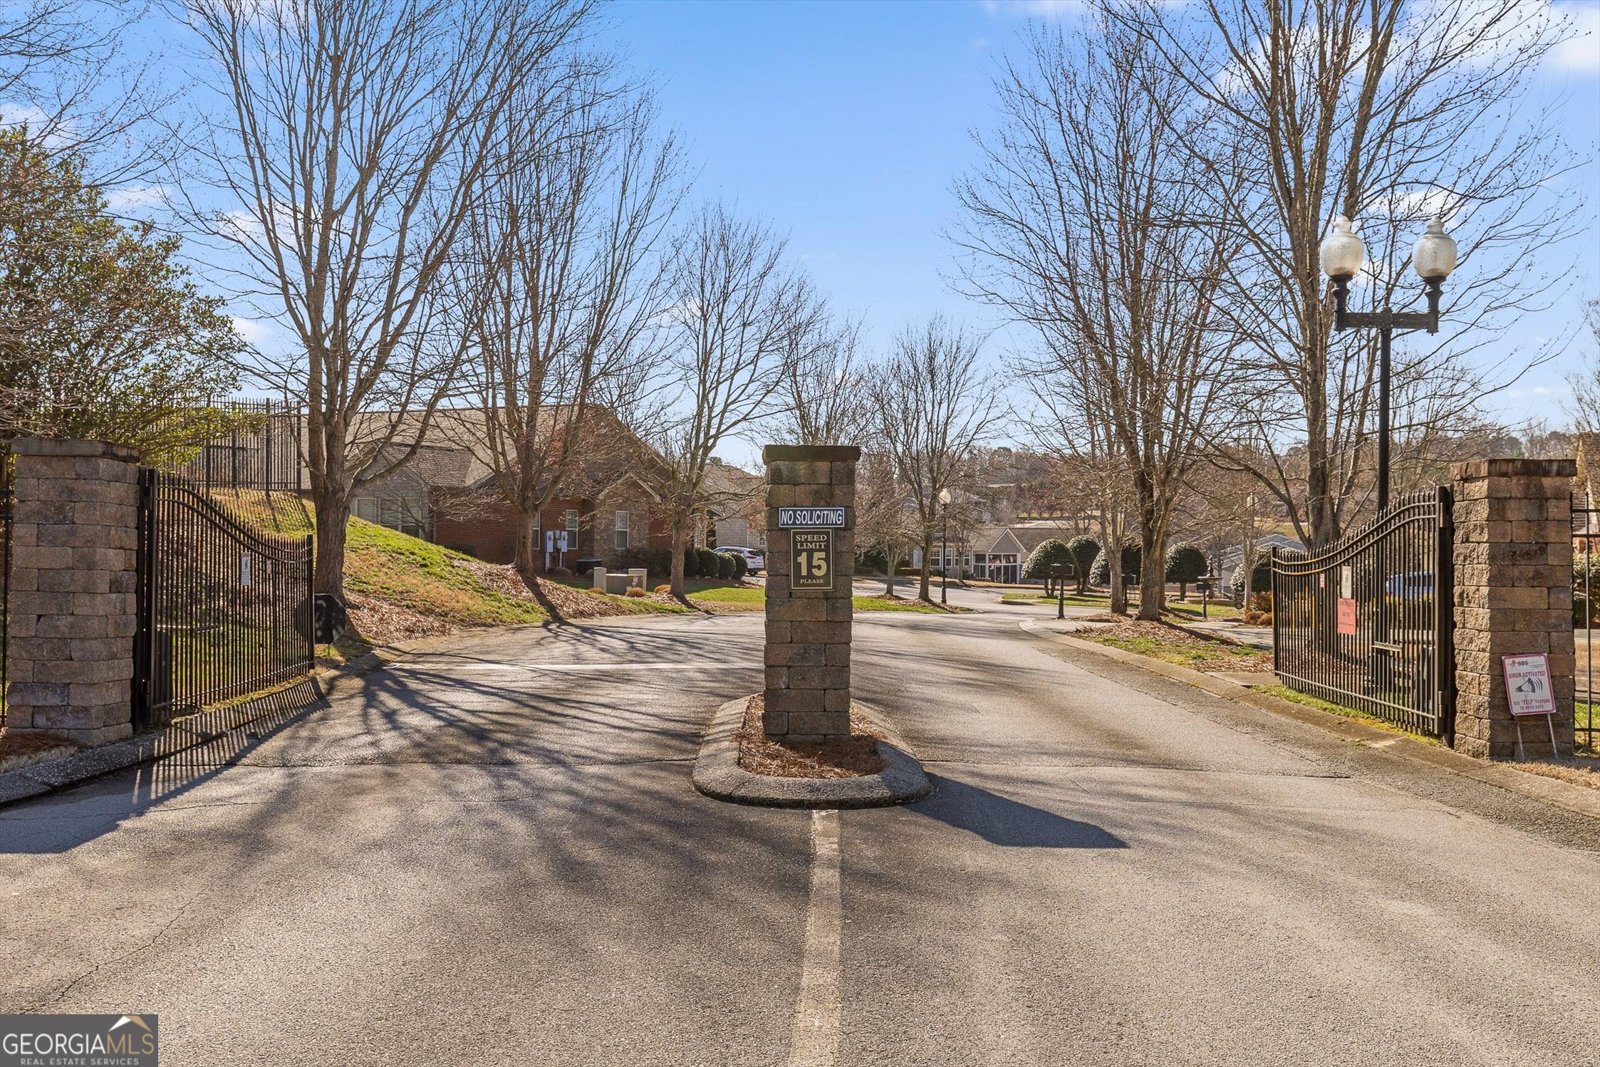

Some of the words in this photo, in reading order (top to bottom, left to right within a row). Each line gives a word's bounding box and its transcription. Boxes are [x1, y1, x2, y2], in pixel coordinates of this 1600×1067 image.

[781, 510, 794, 525] NO
[796, 510, 843, 525] SOLICITING
[795, 534, 827, 542] SPEED
[797, 551, 828, 577] 15
